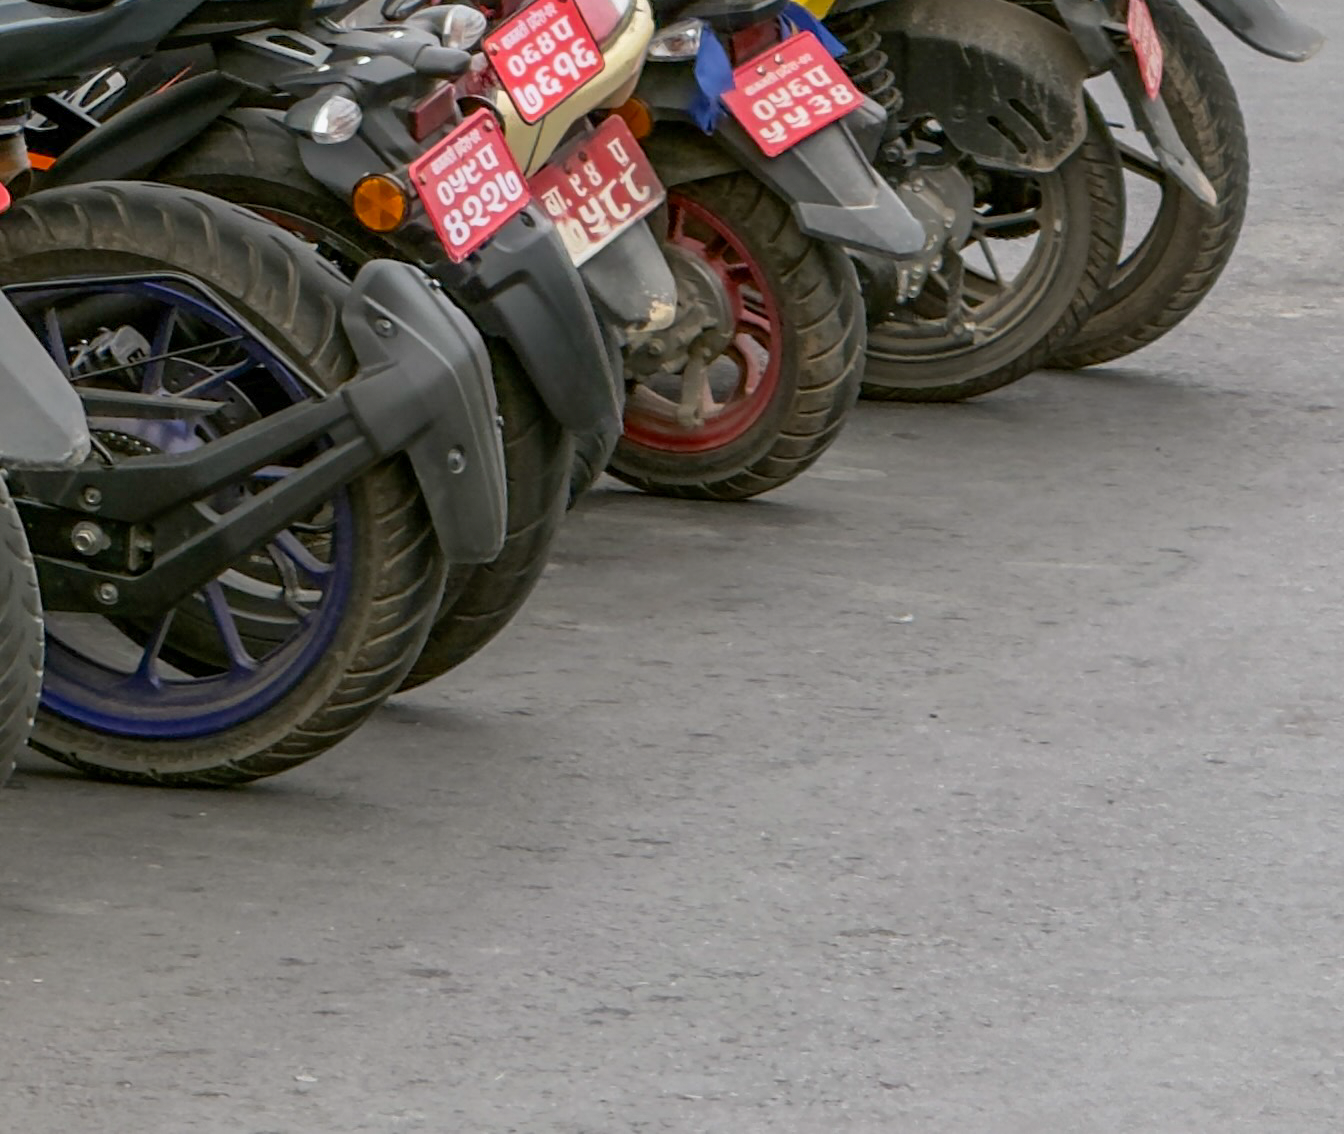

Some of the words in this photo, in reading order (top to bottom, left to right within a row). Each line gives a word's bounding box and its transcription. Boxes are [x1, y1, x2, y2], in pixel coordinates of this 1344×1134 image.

[513, 38, 598, 115] ७६१६
[759, 84, 854, 144] ५५३४
[443, 170, 524, 246] ४२२७
